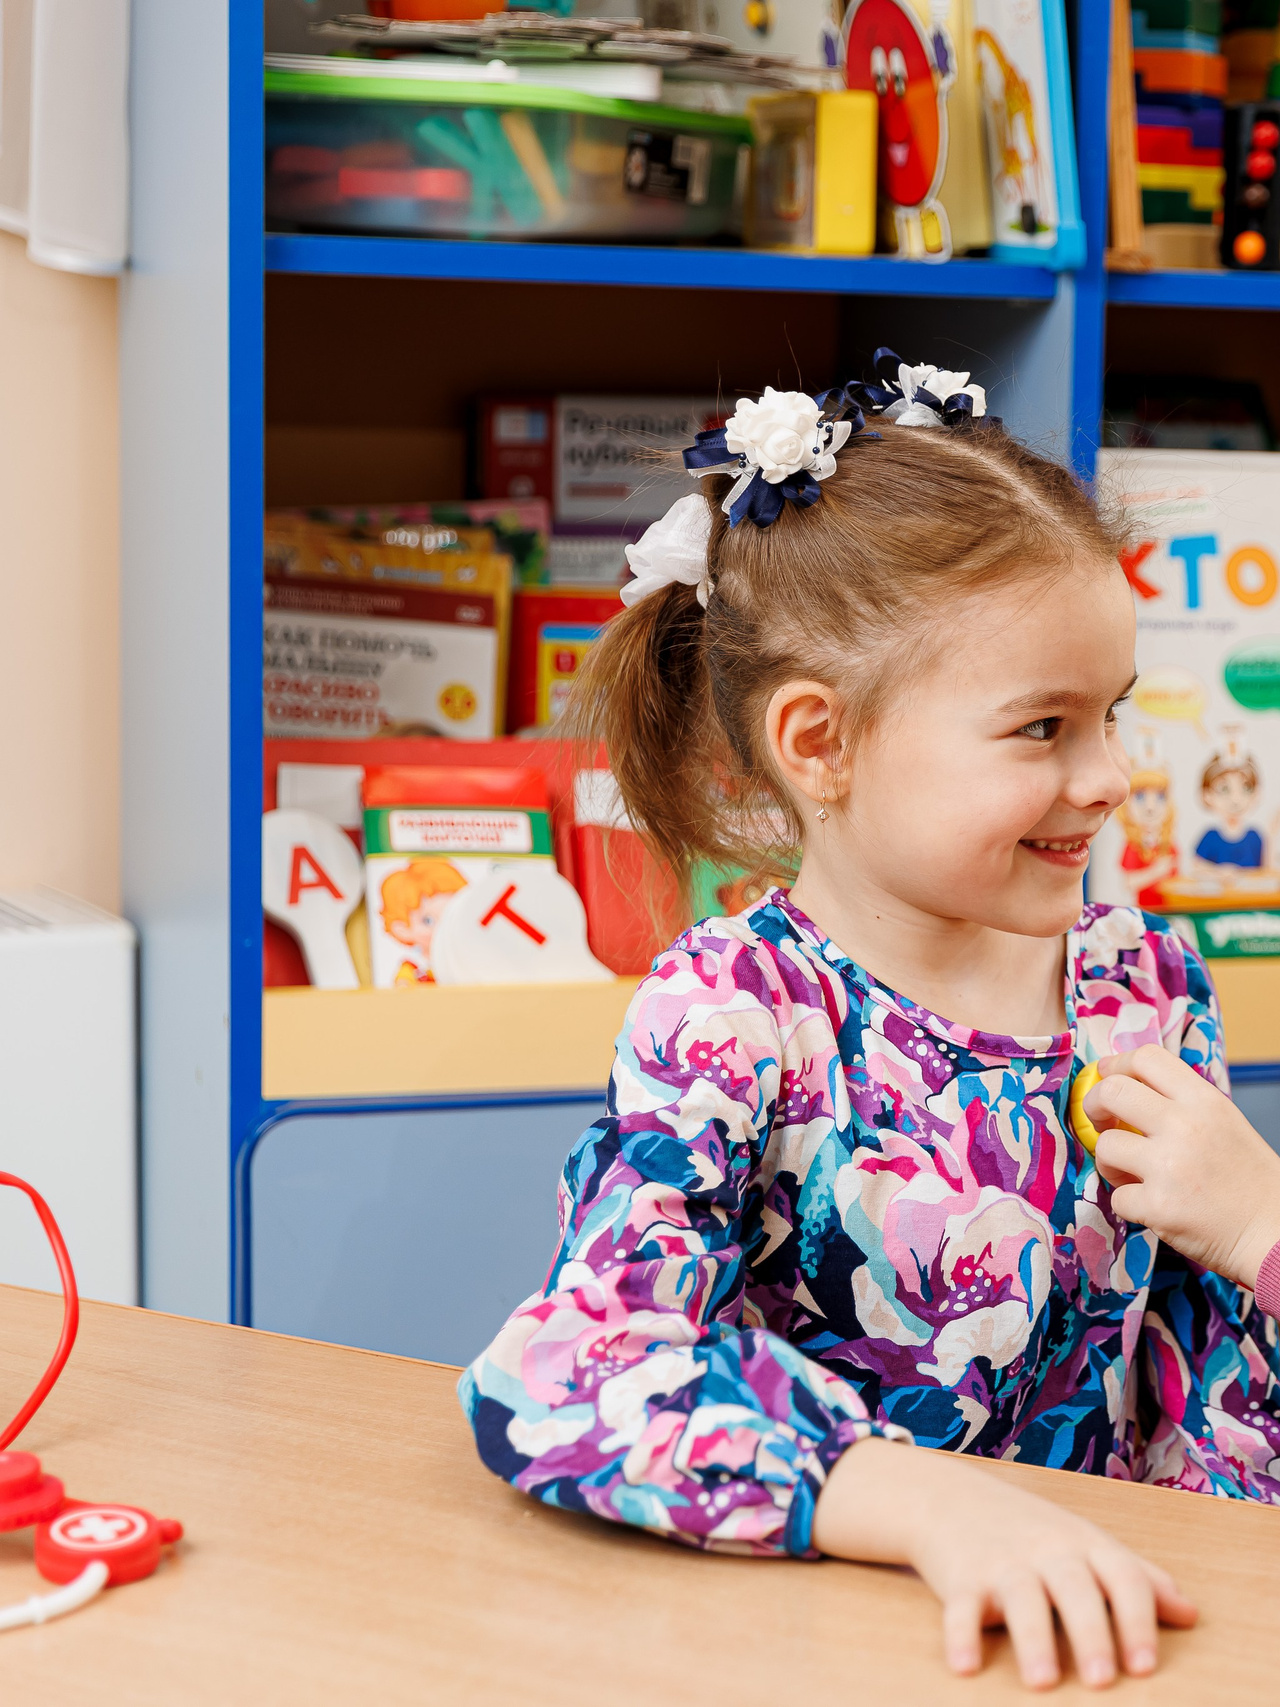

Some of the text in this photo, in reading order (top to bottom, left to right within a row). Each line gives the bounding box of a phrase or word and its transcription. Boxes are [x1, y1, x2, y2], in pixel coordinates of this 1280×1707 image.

[264, 698, 391, 733] ОВОРИТЬ
[286, 845, 346, 906] А
[479, 882, 549, 946] Т
